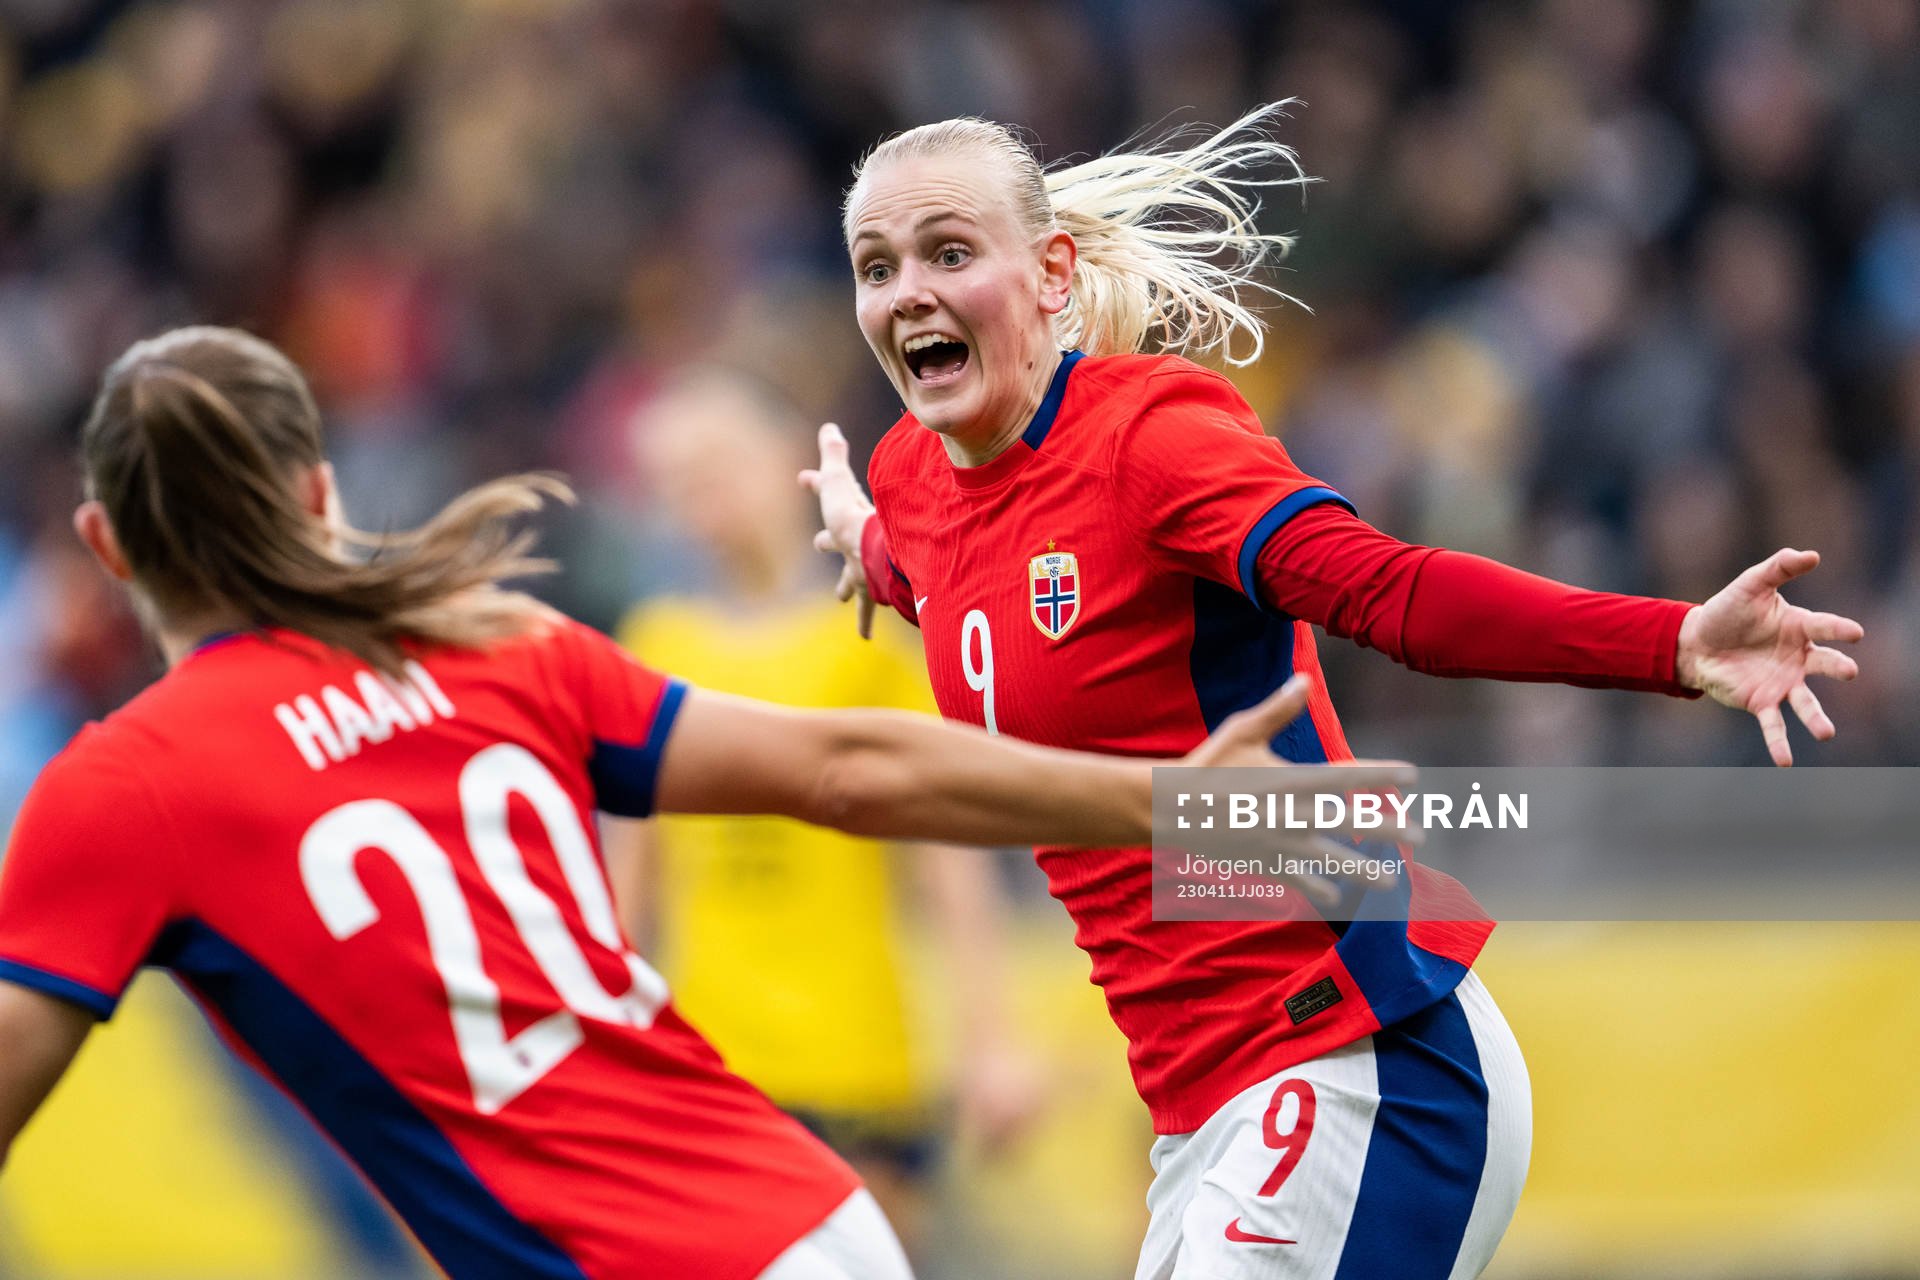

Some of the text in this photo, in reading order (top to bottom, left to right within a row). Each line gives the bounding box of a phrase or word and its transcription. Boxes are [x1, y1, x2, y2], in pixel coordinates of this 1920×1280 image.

[1045, 556, 1061, 565] NORGE
[961, 609, 999, 736] 9
[298, 742, 670, 1116] 20
[1257, 1078, 1317, 1198] 9
